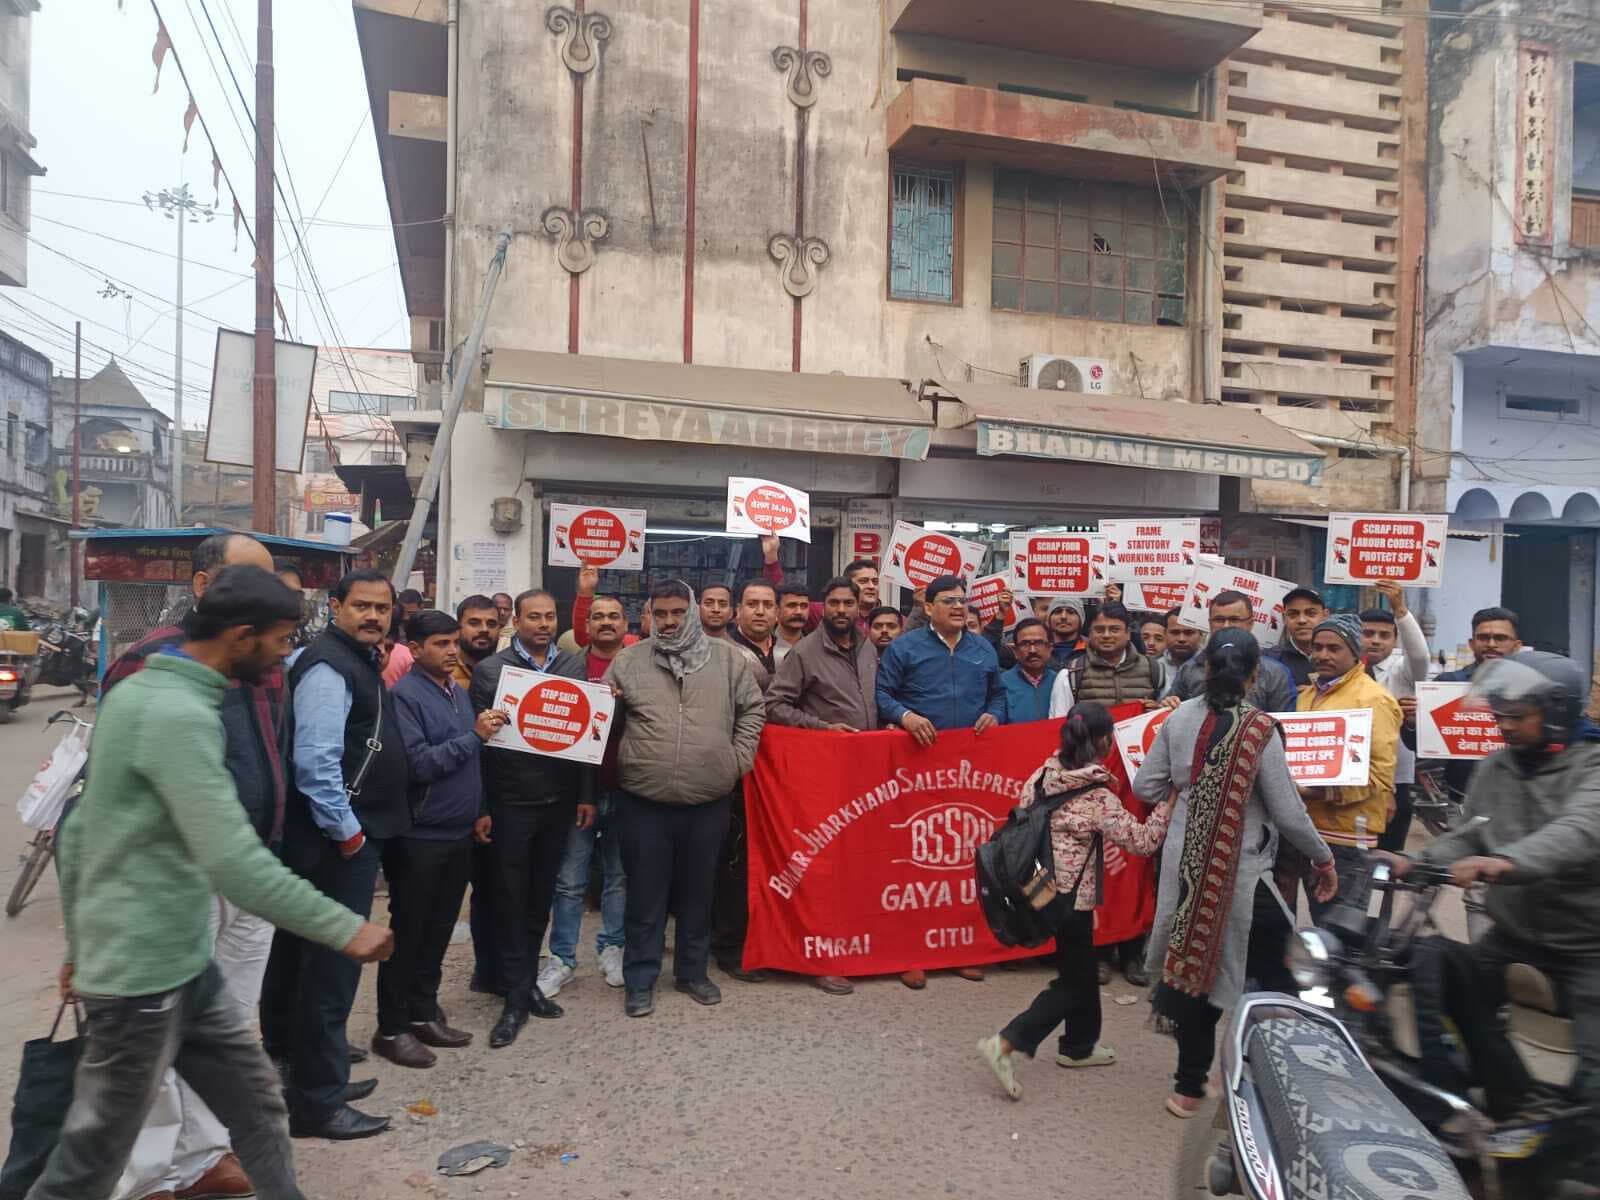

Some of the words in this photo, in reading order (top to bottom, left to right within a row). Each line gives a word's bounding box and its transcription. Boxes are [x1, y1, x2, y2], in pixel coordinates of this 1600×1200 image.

[1090, 382, 1102, 390] LG
[505, 391, 716, 442] SHREYA
[717, 411, 914, 459] AGENCY
[988, 429, 1161, 466] BHADANI
[1173, 447, 1310, 480] MEDICO
[1136, 526, 1162, 536] FRAME
[1362, 524, 1391, 535] SCRAP
[1392, 525, 1415, 535] FOUR
[1036, 541, 1061, 551] SCRAP
[1062, 541, 1081, 551] FOUR
[1127, 540, 1170, 550] STATUTORY
[1352, 537, 1386, 548] LABOUR
[1387, 538, 1415, 549] CODES
[1029, 554, 1057, 564] LABOUR
[1058, 554, 1081, 564] CODES
[1118, 553, 1155, 563] WORKING
[1156, 552, 1180, 563] RULES
[1359, 551, 1397, 562] PROTECT
[1398, 552, 1414, 563] SPE
[1035, 566, 1067, 576] PROTECT
[1067, 566, 1081, 576] SPE
[1134, 566, 1149, 576] FOR
[1150, 566, 1165, 576] SPE
[1232, 576, 1259, 592] FRAME
[540, 688, 560, 700] STOP
[1283, 722, 1311, 734] SCRAP
[1312, 721, 1336, 732] FOUR
[1441, 726, 1465, 736] काम
[1465, 726, 1483, 736] का
[1307, 736, 1335, 747] CODES
[1457, 738, 1479, 751] देना
[1318, 750, 1337, 761] SPE
[769, 850, 811, 899] BIHAR
[793, 778, 900, 855] JHARKHAND
[896, 767, 959, 793] SALES
[958, 759, 1023, 799] REPRES
[881, 880, 953, 911] GAYA
[925, 926, 974, 949] CITU
[804, 933, 871, 959] FMRAI
